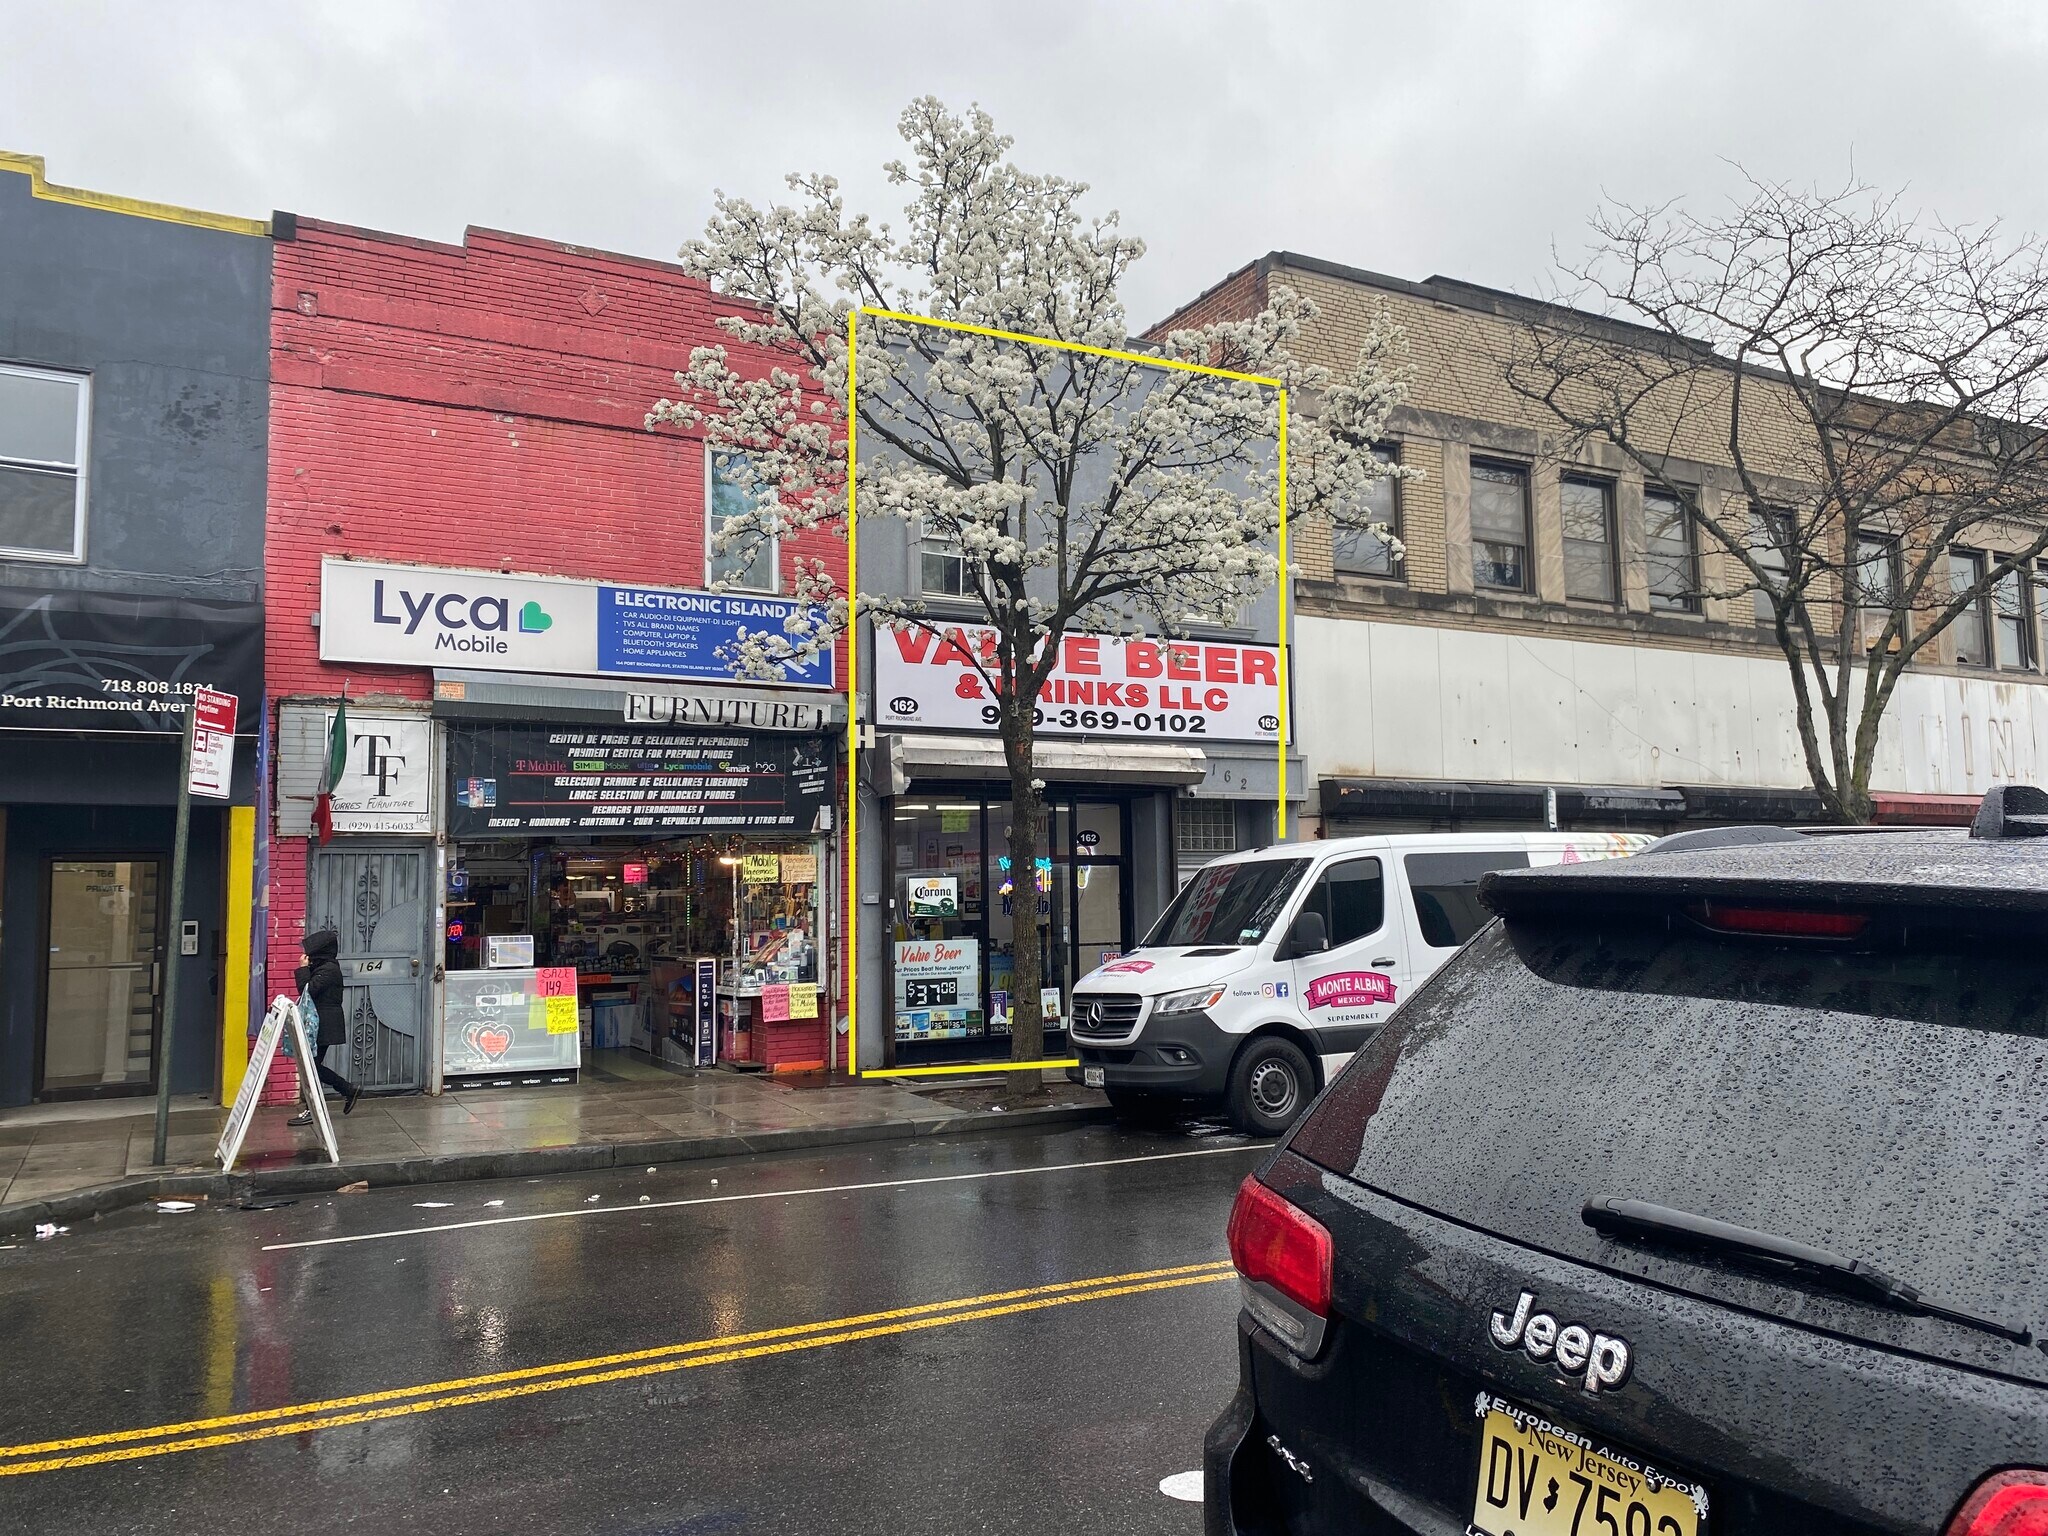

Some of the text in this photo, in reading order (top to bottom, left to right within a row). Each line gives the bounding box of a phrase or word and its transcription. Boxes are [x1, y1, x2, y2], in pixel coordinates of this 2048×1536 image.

[373, 579, 509, 635] Lyca
[615, 591, 786, 619] ELECTRONIC ISLAND
[623, 611, 638, 619] CAR
[651, 622, 675, 630] BRAND
[664, 632, 690, 640] LAPTOP
[434, 632, 509, 655] Mobile
[623, 638, 699, 650] BLUETOOTH SPEAKERS
[623, 647, 687, 658] HOME APPLIANCES
[1126, 640, 1278, 686] BEER
[955, 673, 986, 700] &
[1160, 685, 1229, 712] LLC
[1, 694, 143, 712] Port Richmond
[198, 692, 231, 708] NO STANDING
[197, 702, 219, 715] Anytime
[627, 693, 809, 730] FURNITURE
[892, 700, 1207, 734] 162 99-369-0102
[1260, 717, 1278, 729] 162
[550, 733, 749, 747] CENTRO DE PAGOS DE CELLULARES PREPAGADOS
[567, 748, 733, 760] PAYMENT CENTER FOR PREPAID PHONES
[528, 759, 567, 773] Mobile
[574, 761, 604, 770] SIMPLE
[664, 762, 713, 772] Lycamobile
[725, 765, 751, 773] smart
[554, 777, 749, 787] SELECCION GRANDE DE CELLULARES LIBERADOS
[569, 790, 736, 800] LARGE SELECTION OF UNLOCKED PHONES
[592, 805, 705, 815] RECARGAS INTERNACIONALES A
[348, 821, 372, 831] (929)
[373, 822, 414, 831] 415-6033
[488, 817, 520, 827] MEXICO
[529, 817, 571, 827] HONDURAS
[579, 817, 625, 827] GUATEMALA
[633, 817, 653, 826] CUBA
[661, 816, 700, 826] REPUBLICA
[702, 816, 746, 825] DOMINICANA
[754, 816, 777, 825] OTROS
[778, 816, 795, 825] MAS
[1080, 834, 1097, 842] 162
[86, 884, 125, 893] PRIVATE
[914, 886, 952, 900] Corona
[901, 943, 962, 964] Value Beer
[359, 960, 384, 973] 164
[542, 968, 570, 979] SALE
[1317, 976, 1385, 998] MONTE ALBÁN
[1337, 993, 1366, 1004] MEXICO
[1327, 1012, 1380, 1022] SUPERMARKET
[1490, 1292, 1628, 1392] Jeep
[1491, 1396, 1689, 1494] European Auto Expo
[1528, 1427, 1642, 1498] New Jersey
[1486, 1436, 1539, 1521] DV
